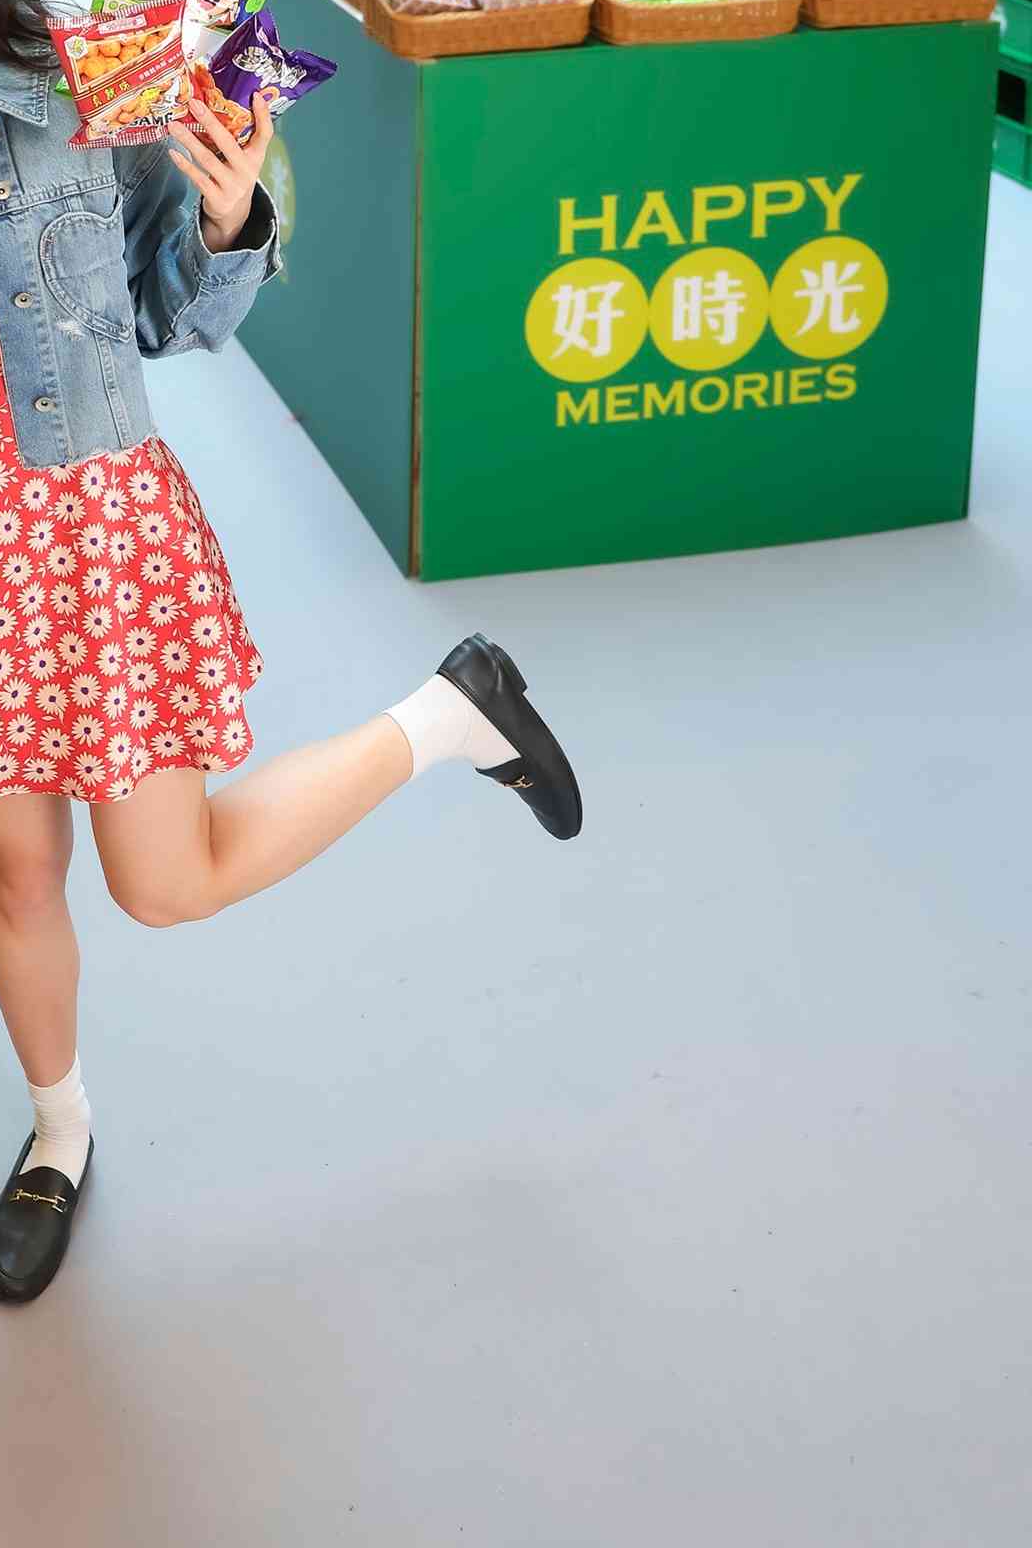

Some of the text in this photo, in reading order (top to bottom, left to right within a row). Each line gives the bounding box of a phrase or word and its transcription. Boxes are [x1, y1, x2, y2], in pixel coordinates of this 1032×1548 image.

[557, 174, 864, 255] HAPPY
[550, 259, 866, 360] 好時光
[555, 363, 859, 428] MEMORIES
